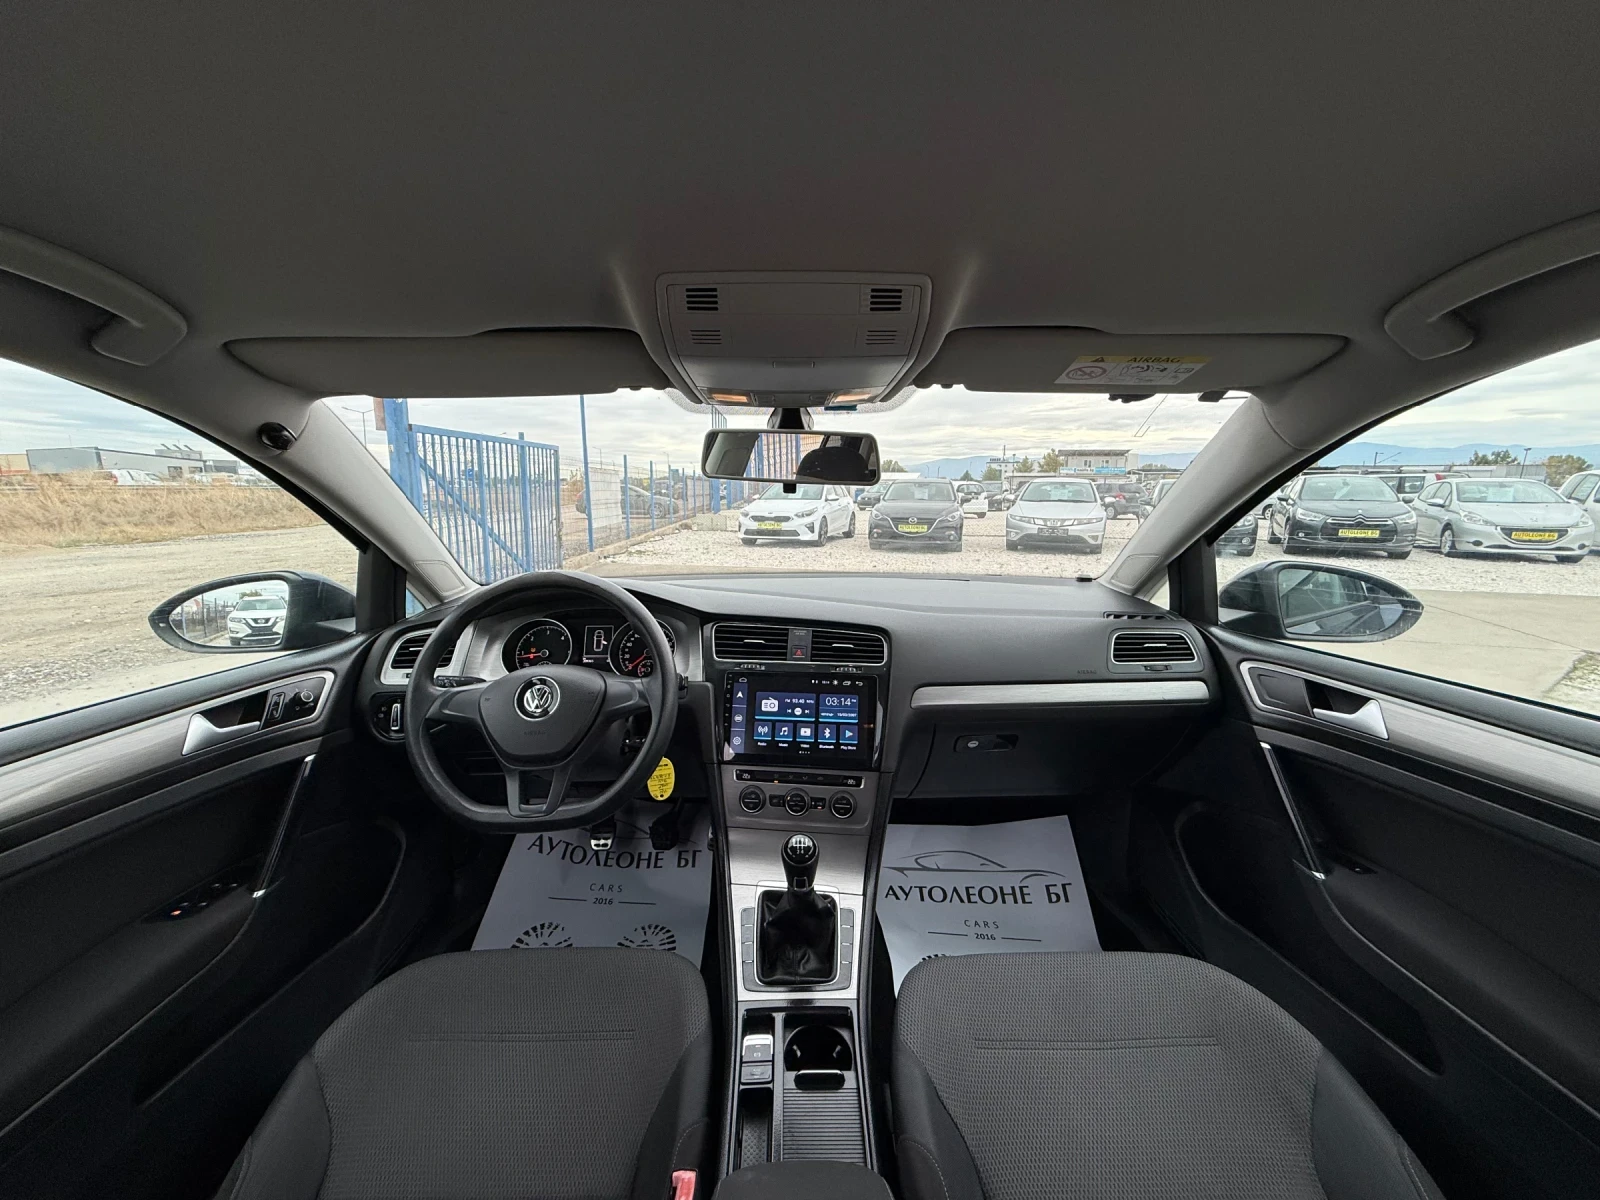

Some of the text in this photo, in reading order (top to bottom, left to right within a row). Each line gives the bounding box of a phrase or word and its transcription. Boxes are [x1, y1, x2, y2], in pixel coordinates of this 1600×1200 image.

[825, 697, 851, 706] 03:14
[527, 834, 702, 869] АУТОЛЕОНЕ БГ
[589, 883, 623, 893] CARS
[884, 882, 1072, 904] АУТОЛЕОНЕ БГ
[592, 897, 614, 905] 2016
[964, 919, 999, 929] CARS
[974, 932, 996, 941] 2016
